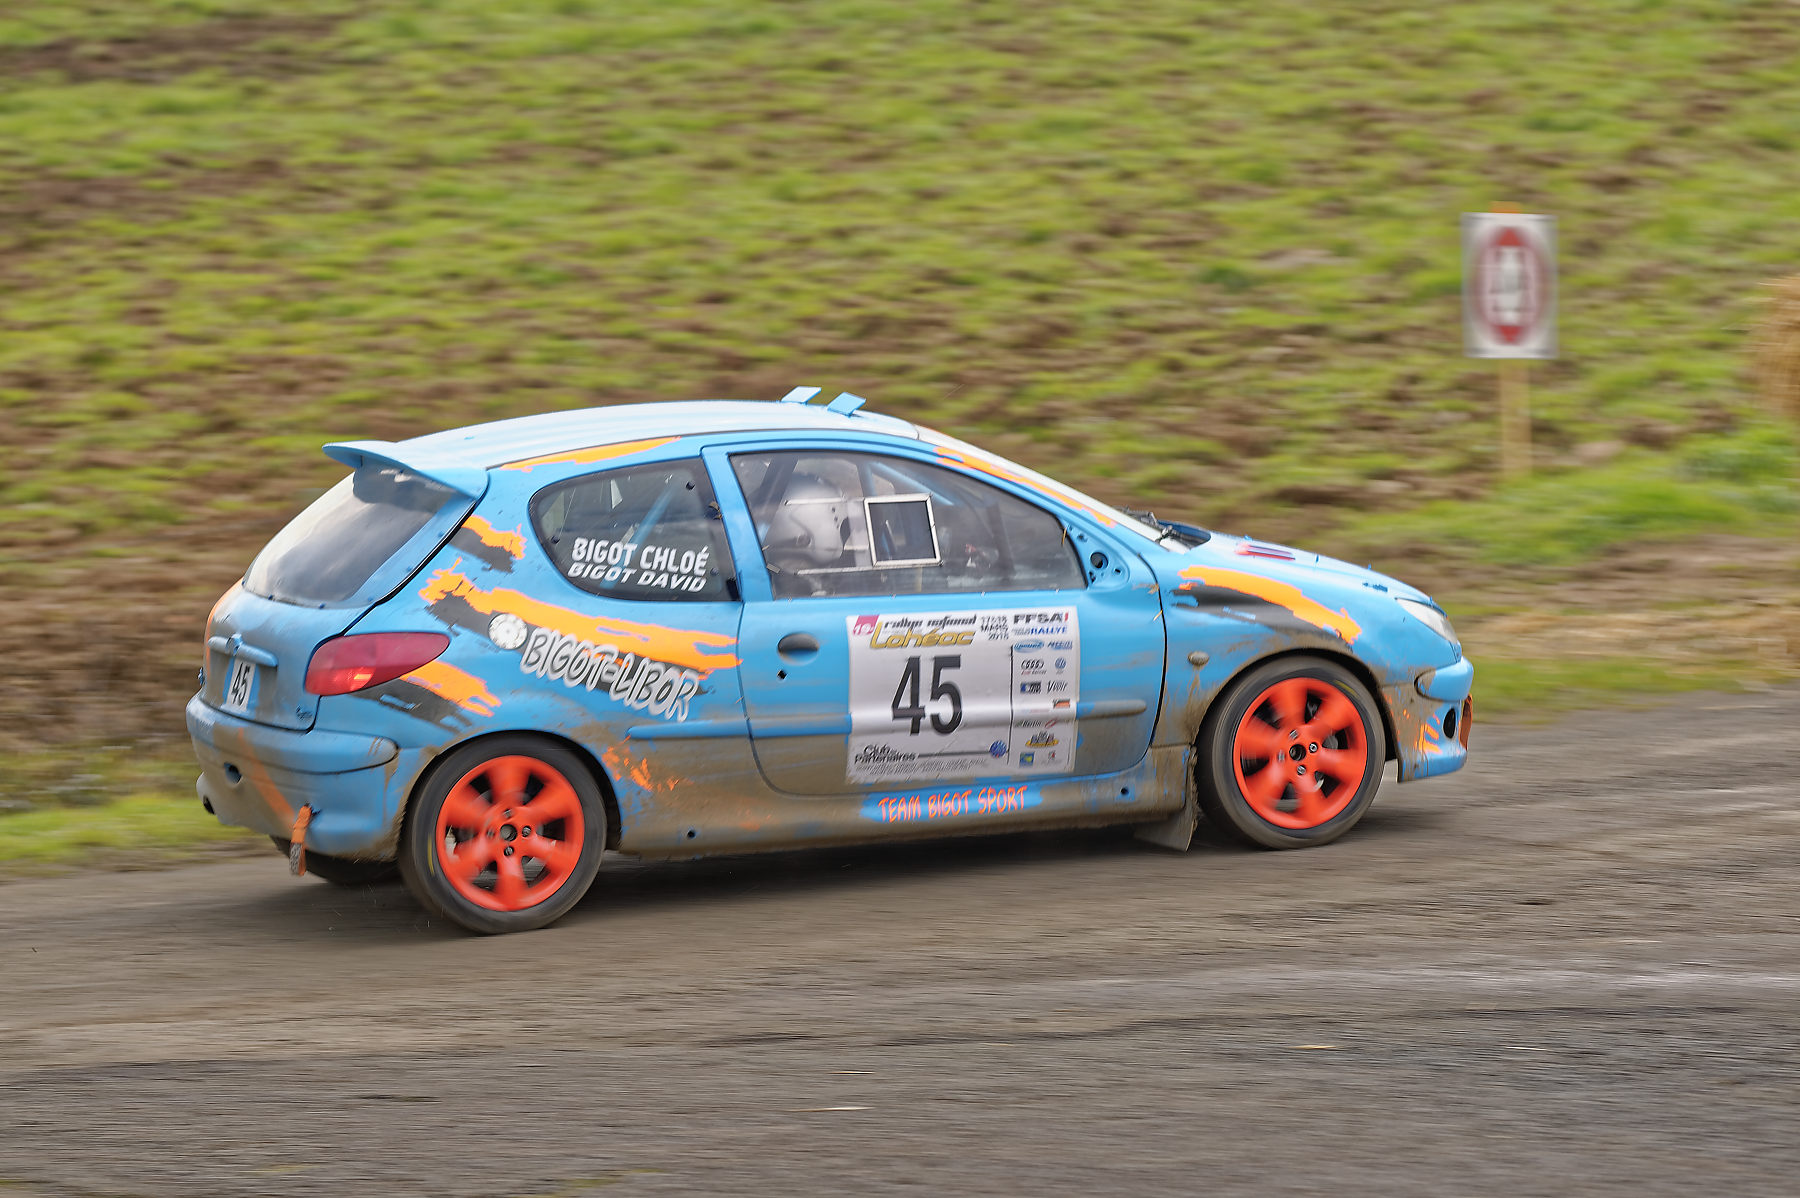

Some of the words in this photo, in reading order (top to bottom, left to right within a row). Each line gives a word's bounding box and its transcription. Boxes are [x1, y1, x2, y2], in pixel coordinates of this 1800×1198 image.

[571, 537, 637, 566] BIGOT
[639, 545, 709, 576] CHLOÉ
[567, 562, 637, 584] BIGOT
[637, 573, 707, 593] DAVID
[870, 620, 976, 649] Lohéac
[884, 617, 923, 630] rallye
[927, 614, 977, 629] national
[1030, 626, 1067, 635] RALLYE
[231, 662, 251, 706] 45
[520, 627, 700, 722] BIGOT-LIBOR
[891, 654, 963, 736] 45
[854, 752, 917, 765] Partenaires
[863, 743, 891, 756] Club
[878, 794, 922, 823] TEAM
[928, 789, 973, 818] BIGOT
[978, 785, 1028, 815] SPORT
